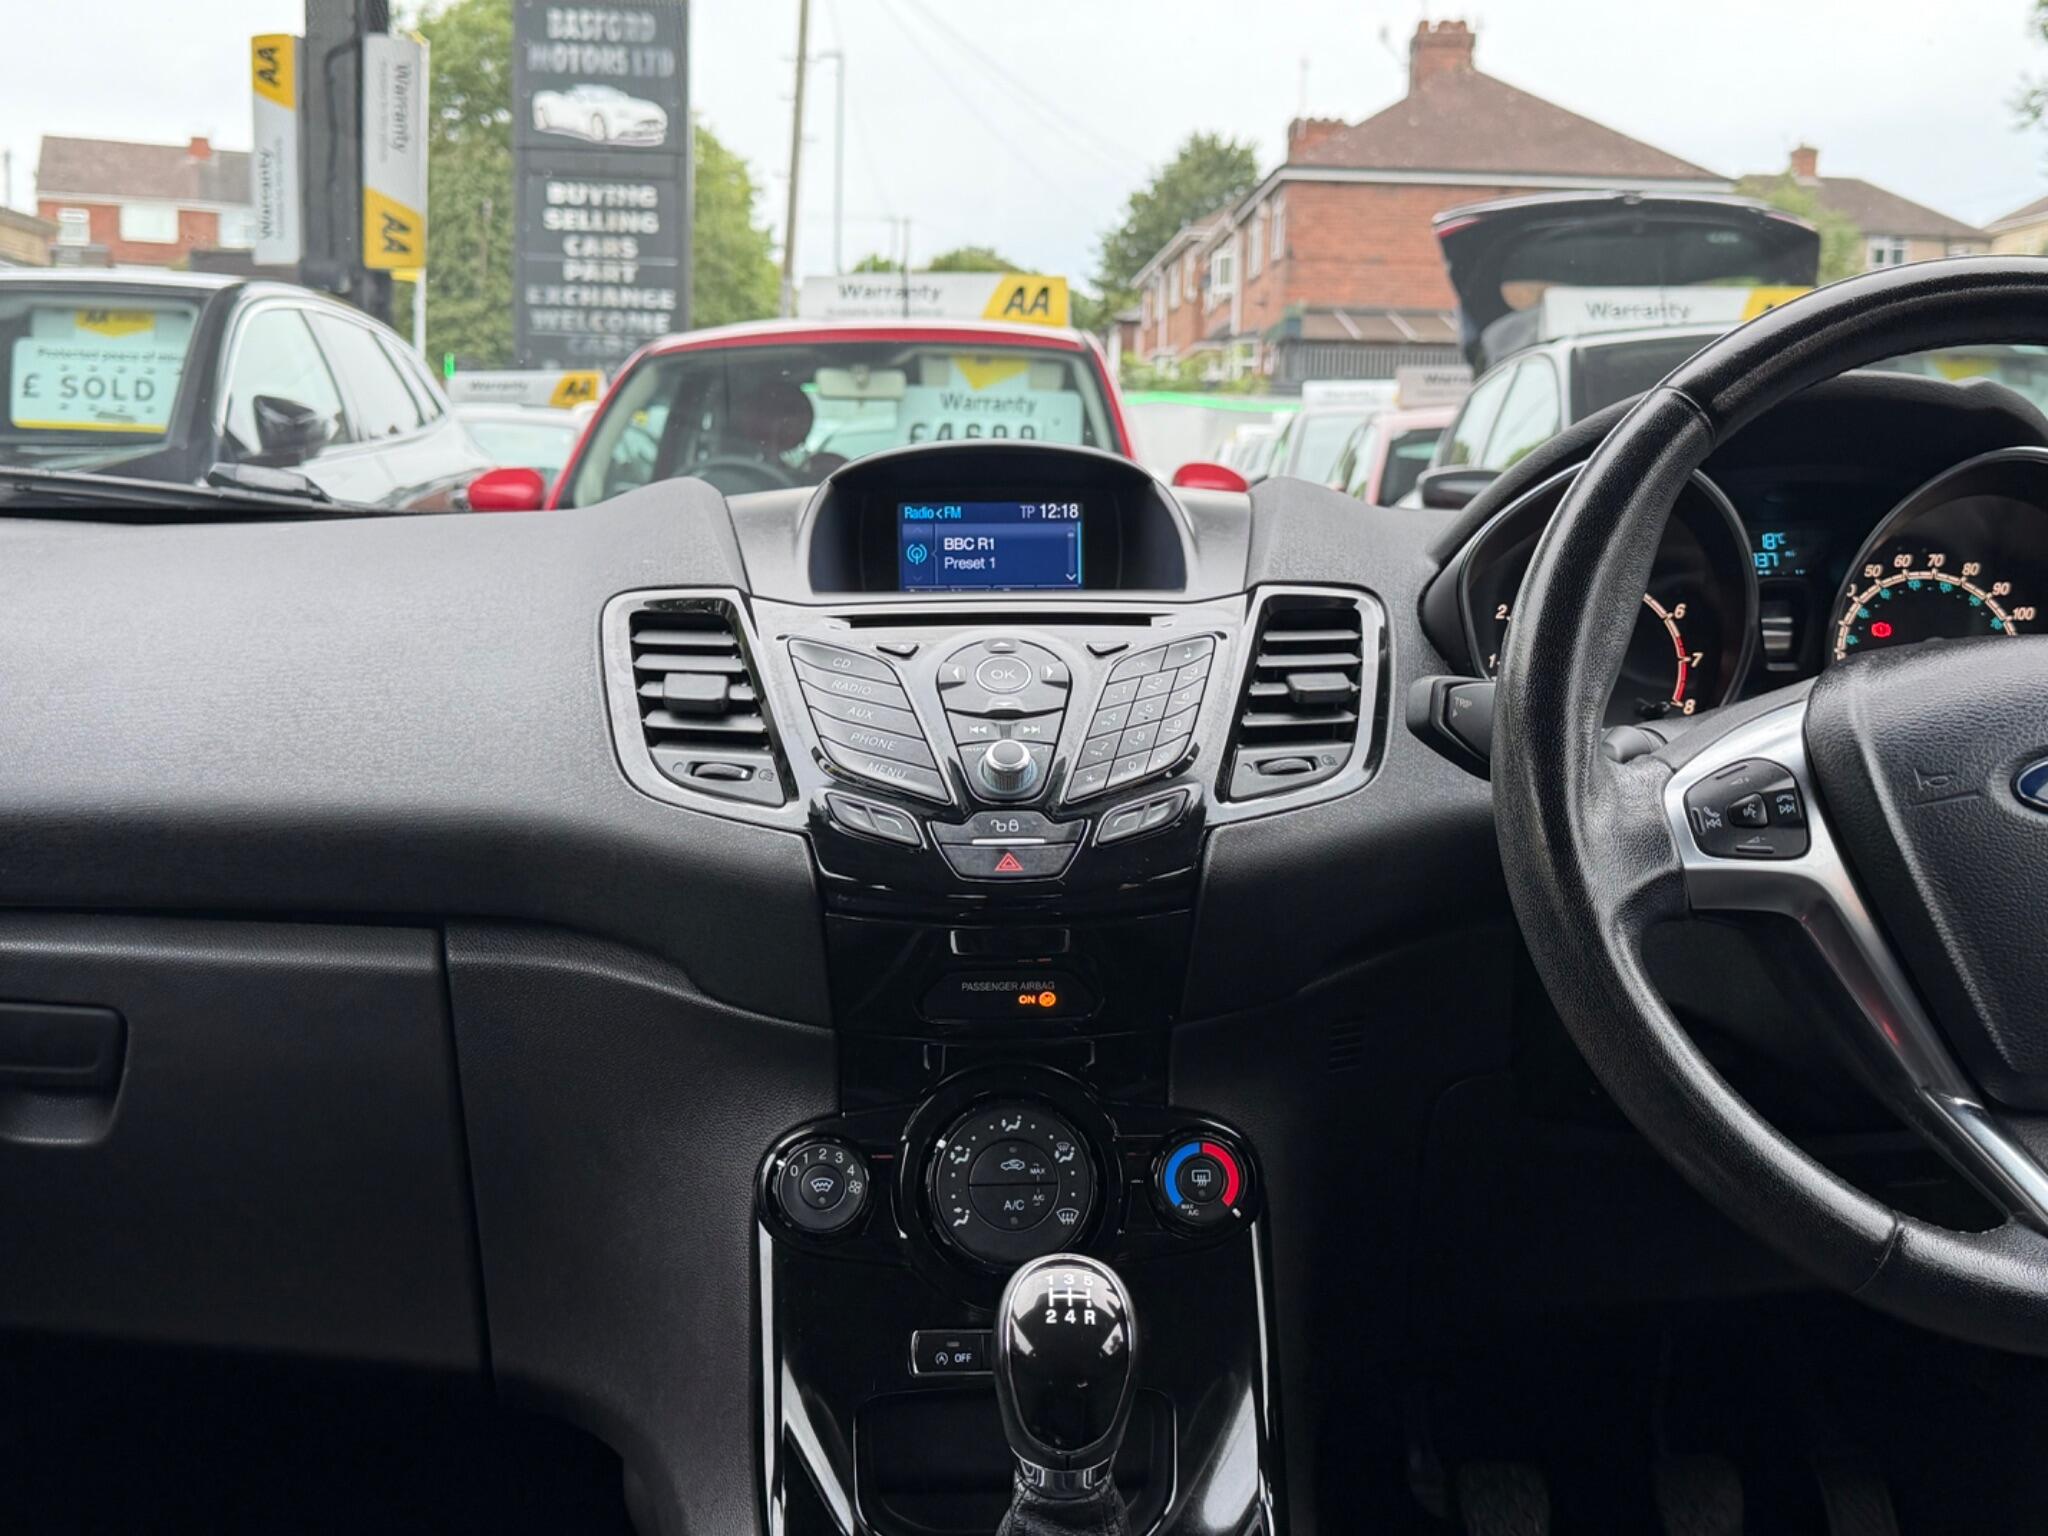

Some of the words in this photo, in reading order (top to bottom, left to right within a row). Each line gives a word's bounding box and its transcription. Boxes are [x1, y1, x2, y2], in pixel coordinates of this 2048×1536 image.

[257, 46, 280, 88] AA
[391, 63, 412, 155] Warranty
[259, 152, 274, 240] Warranty
[546, 181, 659, 208] BUYING
[542, 206, 660, 234] SELLING
[382, 211, 412, 255] AA
[562, 234, 639, 259] CARS
[562, 258, 639, 284] PART
[525, 284, 677, 311] EXCHANGE
[838, 285, 942, 302] Warranty
[1003, 285, 1051, 318] AA
[1584, 301, 1692, 321] Warranty
[529, 308, 672, 335] WELCOME
[22, 373, 41, 399] £
[59, 375, 156, 402] SOLD
[940, 391, 1038, 417] Warranty
[1020, 505, 1035, 519] TP
[1039, 503, 1079, 519] 12:18
[943, 537, 975, 551] BBC
[977, 537, 995, 551] R1
[944, 556, 985, 570] Preset
[989, 557, 996, 569] 1
[1894, 554, 1912, 568] 60
[1927, 554, 1945, 568] 70
[1962, 562, 1980, 576] 80
[1864, 564, 1882, 578] 50
[1992, 581, 2010, 596] 90
[1495, 604, 1508, 619] 2
[1674, 603, 1686, 619] 6
[2012, 606, 2036, 620] 100
[832, 655, 852, 669] CD
[1488, 653, 1497, 669] 1
[1691, 652, 1704, 668] 7
[991, 669, 1016, 680] OK
[831, 678, 873, 696] RADIO
[847, 705, 875, 721] AUX
[1683, 698, 1696, 715] 8
[850, 731, 898, 752] PHONE
[867, 760, 908, 780] MENU
[962, 981, 1018, 991] PASSENGER
[1020, 981, 1055, 991] AIRBAG
[1018, 994, 1036, 1005] ON
[803, 1152, 809, 1164] 1
[819, 1148, 827, 1160] 2
[835, 1152, 844, 1164] 3
[789, 1165, 798, 1177] 0
[847, 1164, 855, 1176] 4
[1004, 1200, 1025, 1211] A/C
[1063, 1274, 1074, 1286] 3
[1083, 1274, 1094, 1287] 5
[1046, 1309, 1057, 1324] 2
[1063, 1309, 1076, 1325] 4
[1084, 1309, 1096, 1325] R
[954, 1353, 972, 1363] OFF
